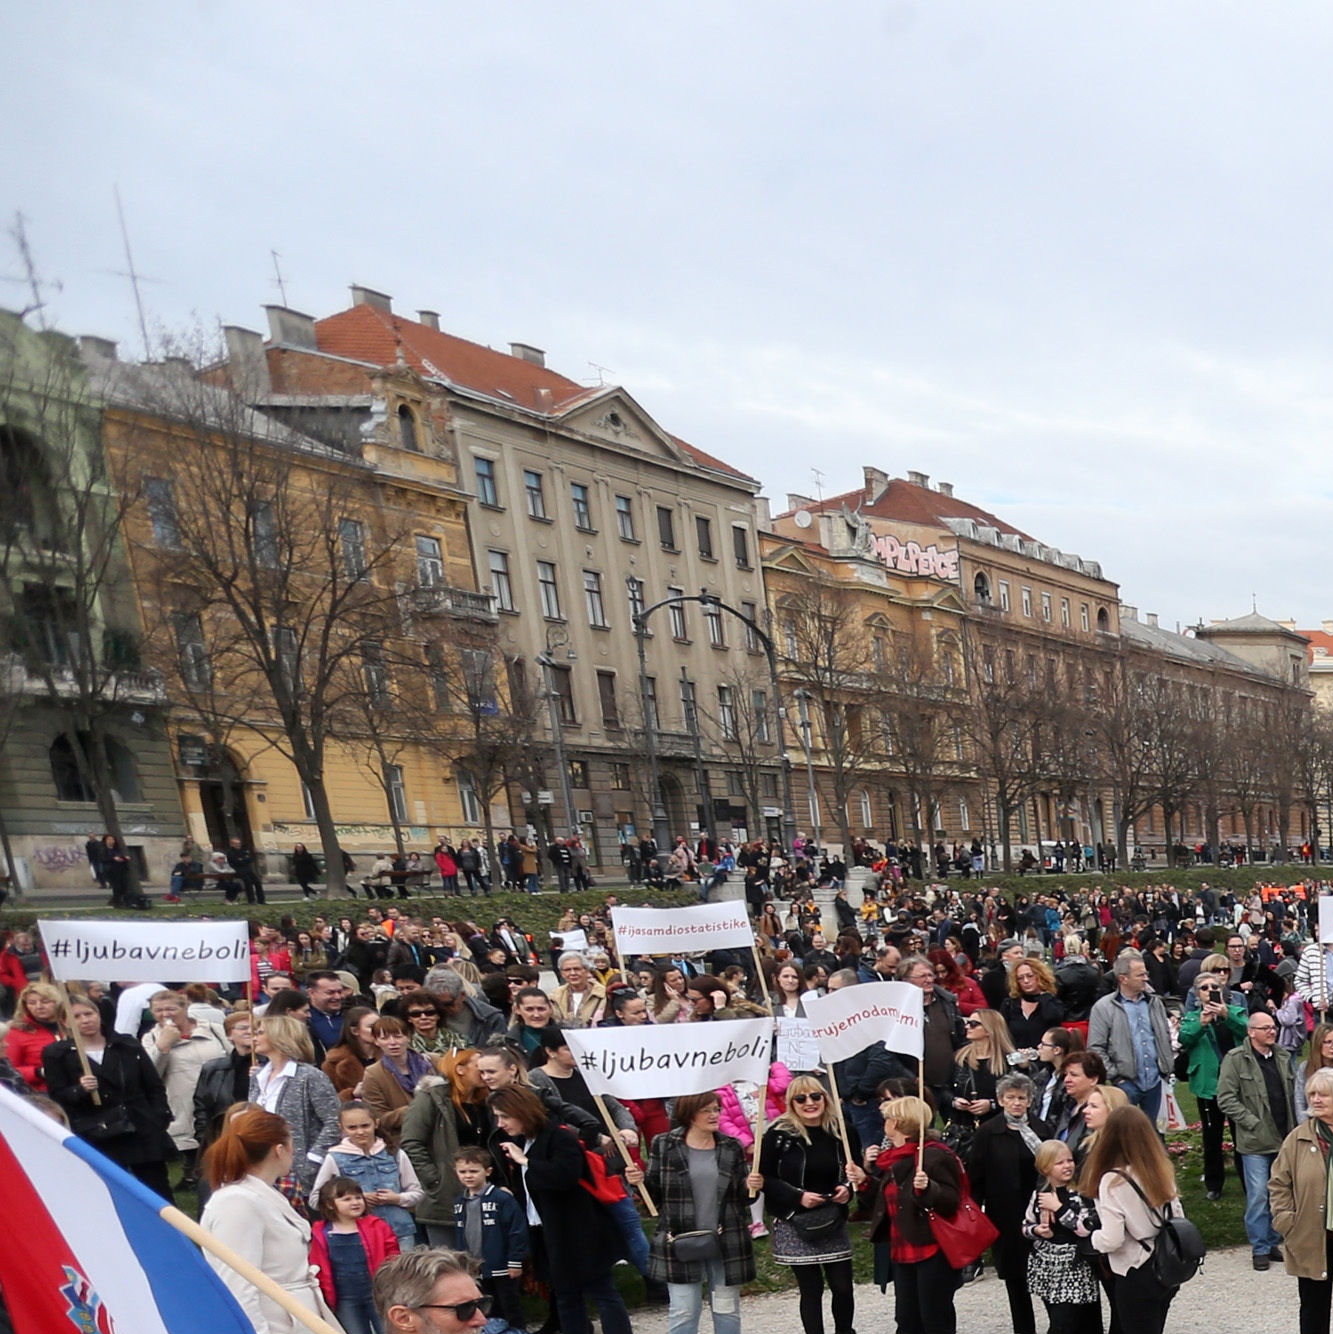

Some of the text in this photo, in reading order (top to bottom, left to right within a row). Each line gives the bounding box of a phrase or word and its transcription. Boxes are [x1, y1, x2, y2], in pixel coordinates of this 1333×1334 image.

[617, 918, 748, 938] #ijasamdiostatistike
[51, 938, 248, 964] #ljubavneboli
[779, 1021, 811, 1040] Ljuba
[581, 1036, 769, 1079] #ljubavneboli
